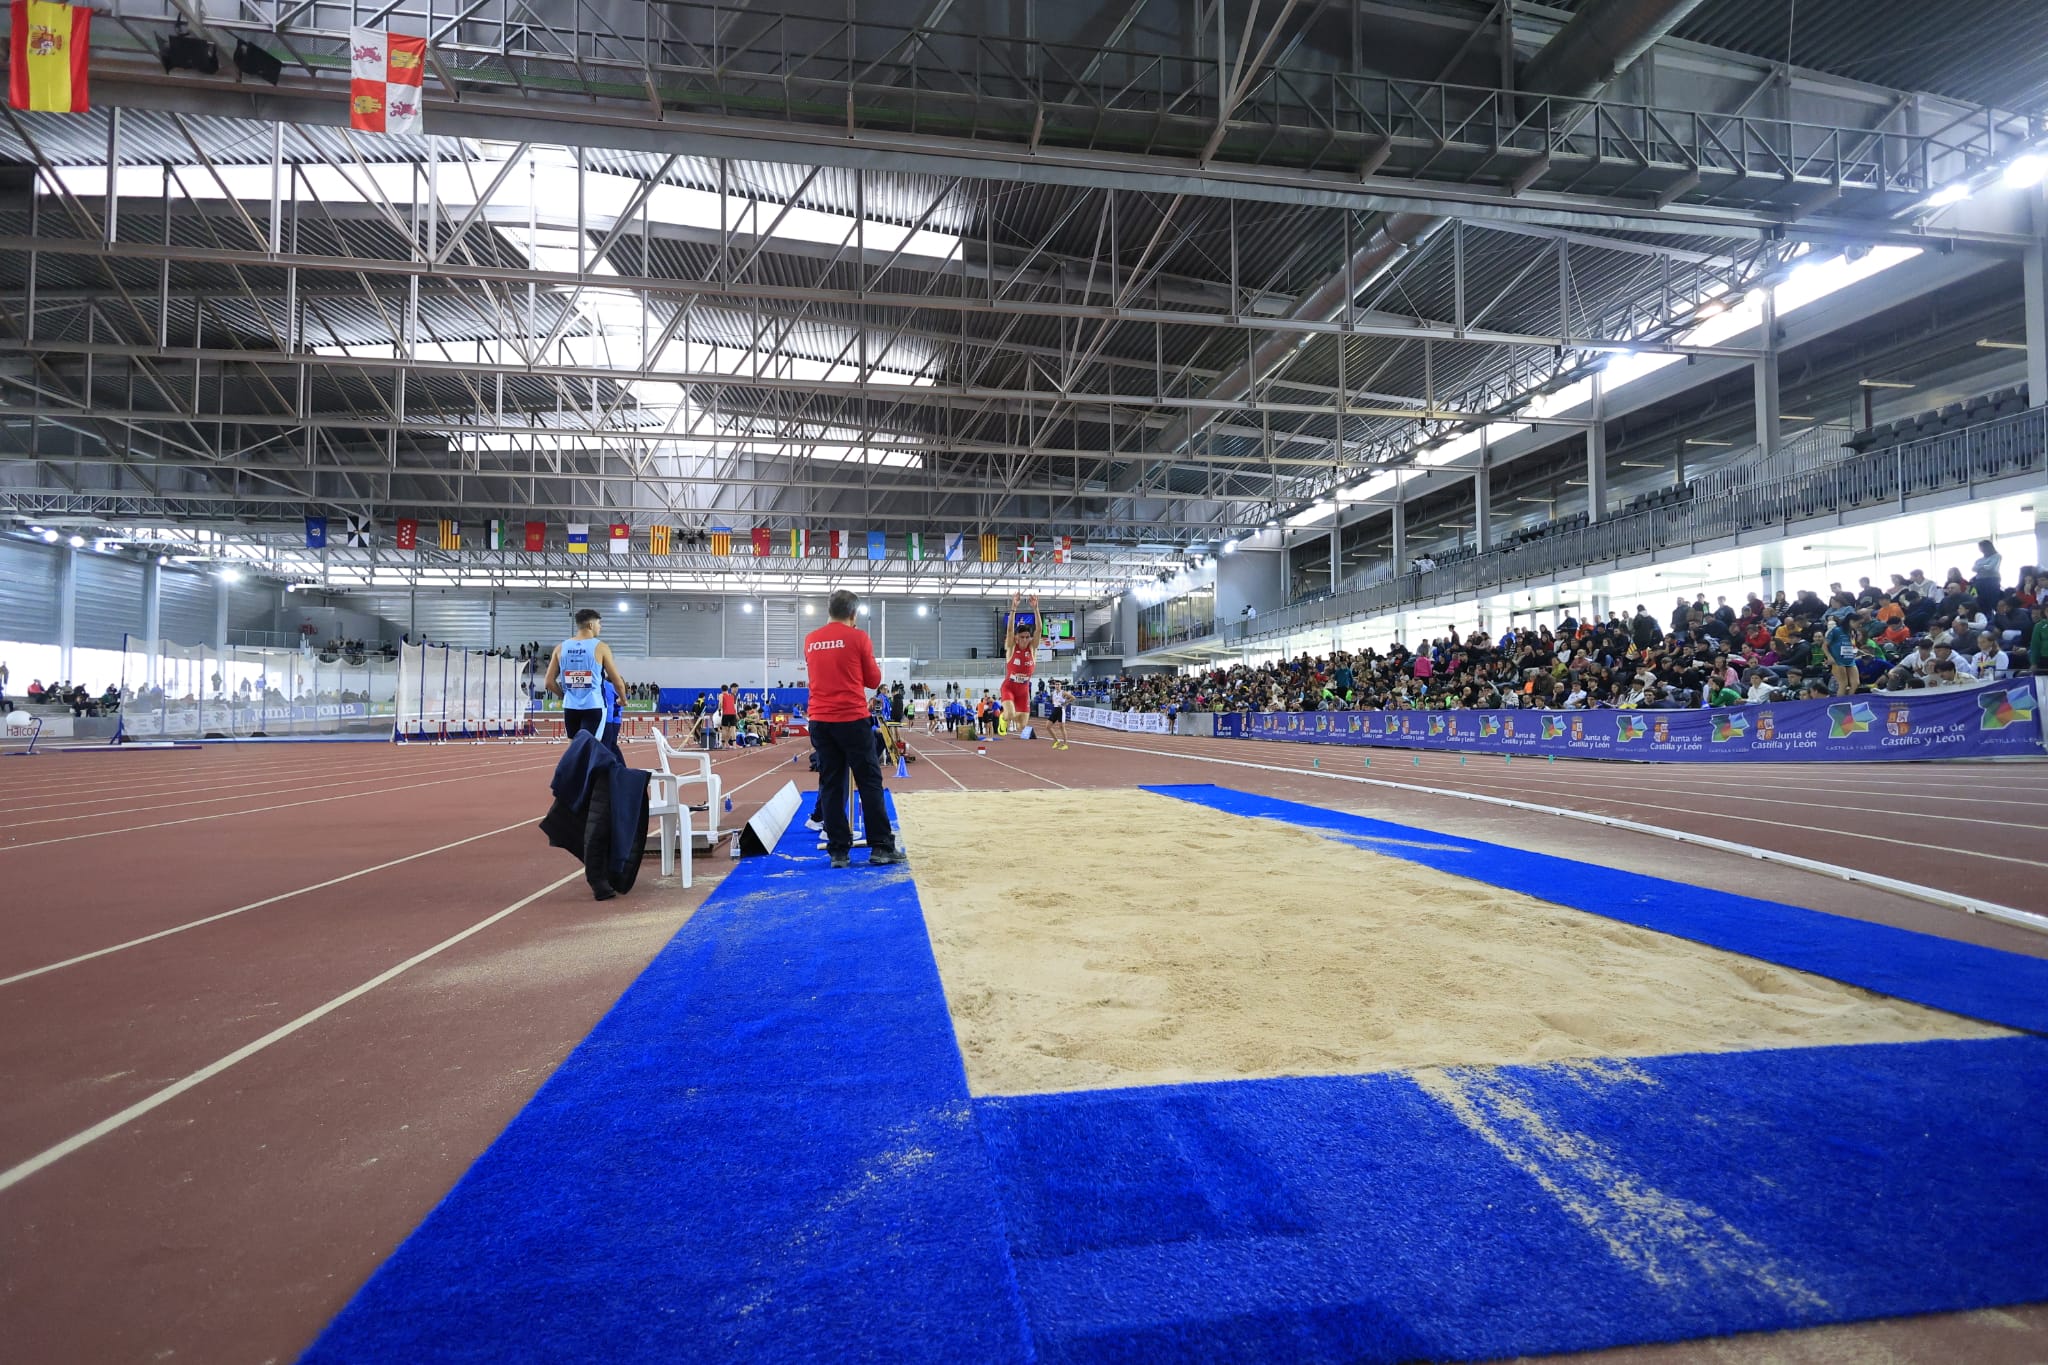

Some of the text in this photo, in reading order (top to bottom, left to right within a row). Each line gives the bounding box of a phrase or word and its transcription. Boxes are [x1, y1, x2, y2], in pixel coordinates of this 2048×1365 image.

[1912, 723, 1966, 735] Junta de
[1670, 735, 1690, 743] Junta
[1776, 730, 1817, 740] Junta de
[1881, 733, 1966, 747] Castilla y León
[1650, 742, 1675, 750] Castilla
[1676, 744, 1682, 752] y
[1683, 742, 1703, 750] León
[1751, 740, 1817, 750] Castilla y León
